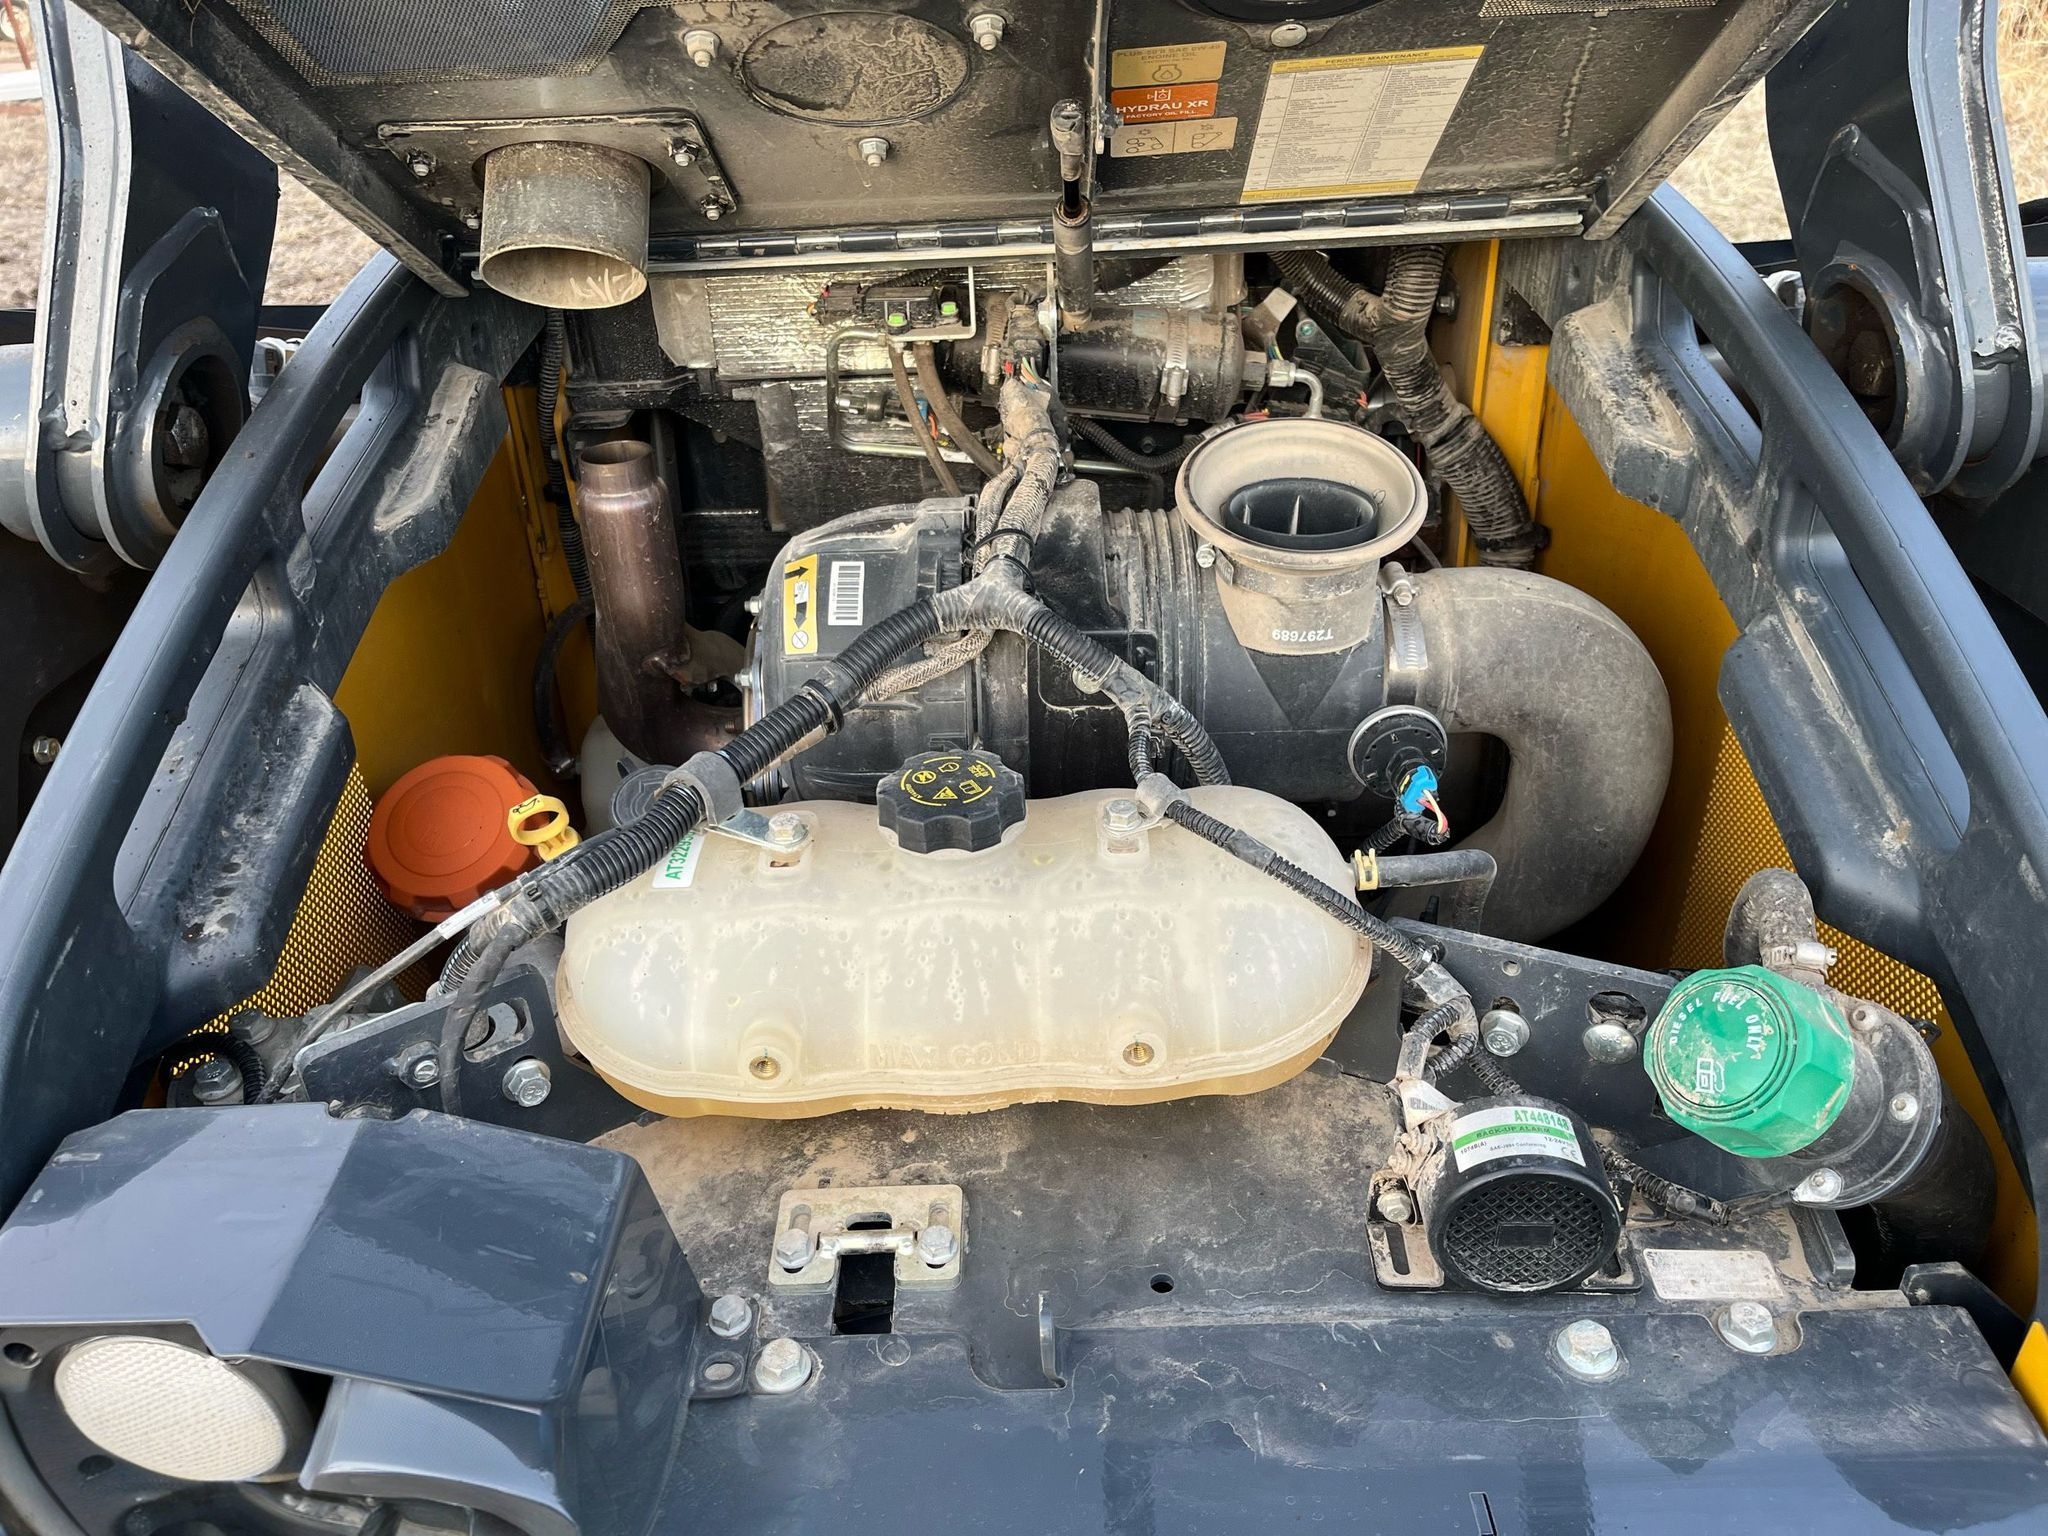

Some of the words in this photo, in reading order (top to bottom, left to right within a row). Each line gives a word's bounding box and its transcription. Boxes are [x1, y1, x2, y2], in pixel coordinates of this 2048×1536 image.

[1141, 53, 1177, 61] ENGINE
[1325, 56, 1366, 65] PERIODIC
[1367, 51, 1430, 61] MAINTENANCE
[1116, 101, 1182, 114] HYDRAU
[1187, 100, 1209, 108] XR
[1271, 628, 1335, 642] T297689
[1669, 997, 1703, 1046] DIESEL
[1711, 991, 1747, 1010] FUEL
[1745, 1014, 1762, 1053] ONLY
[1513, 1110, 1569, 1131] AT448148
[1476, 1126, 1517, 1138] BACK-UP
[1519, 1126, 1551, 1134] ALARM
